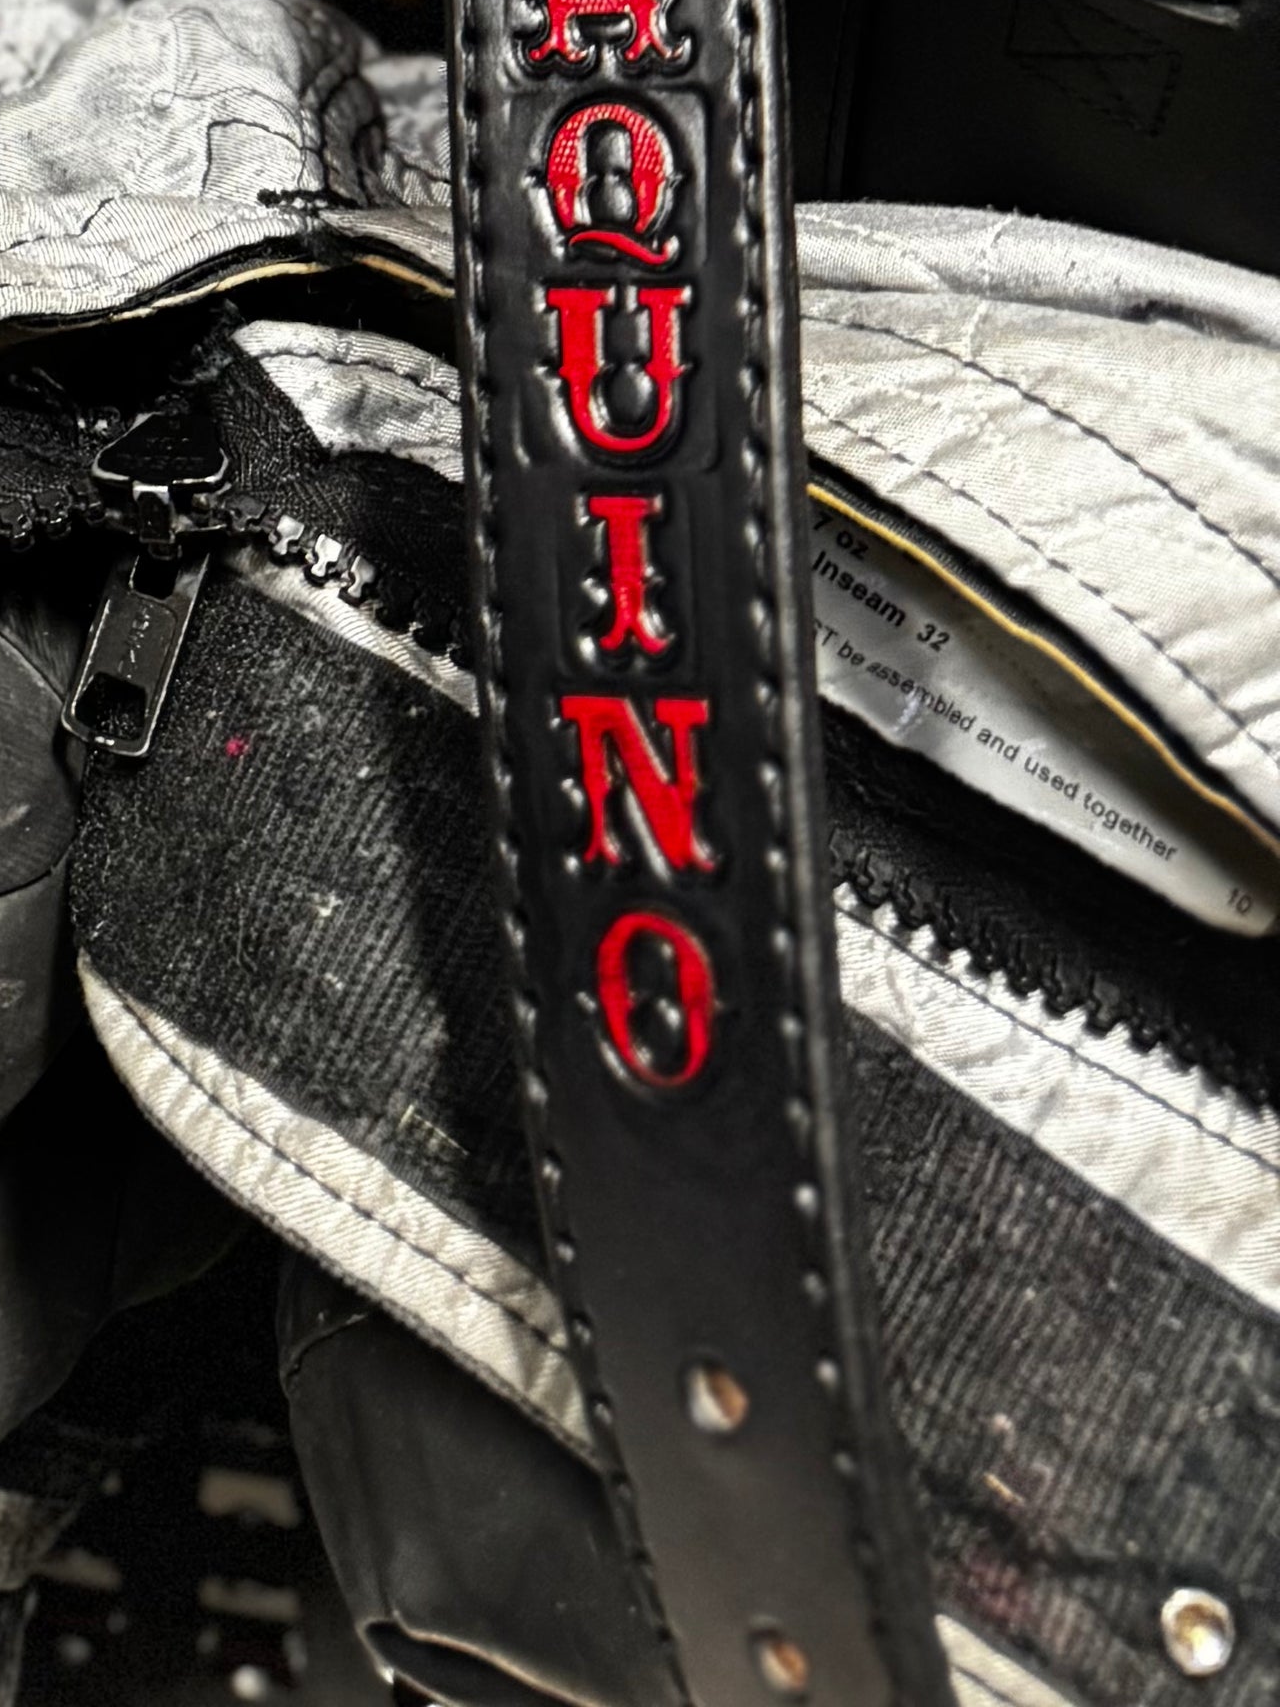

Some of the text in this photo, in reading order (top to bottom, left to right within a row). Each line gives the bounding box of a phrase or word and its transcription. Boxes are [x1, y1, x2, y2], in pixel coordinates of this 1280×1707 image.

[835, 530, 870, 561] oz
[811, 550, 951, 653] Inseam 32
[837, 639, 866, 667] be
[866, 662, 978, 732] assembled
[976, 727, 1021, 763] and
[1023, 754, 1081, 801] used
[1082, 790, 1179, 862] together
